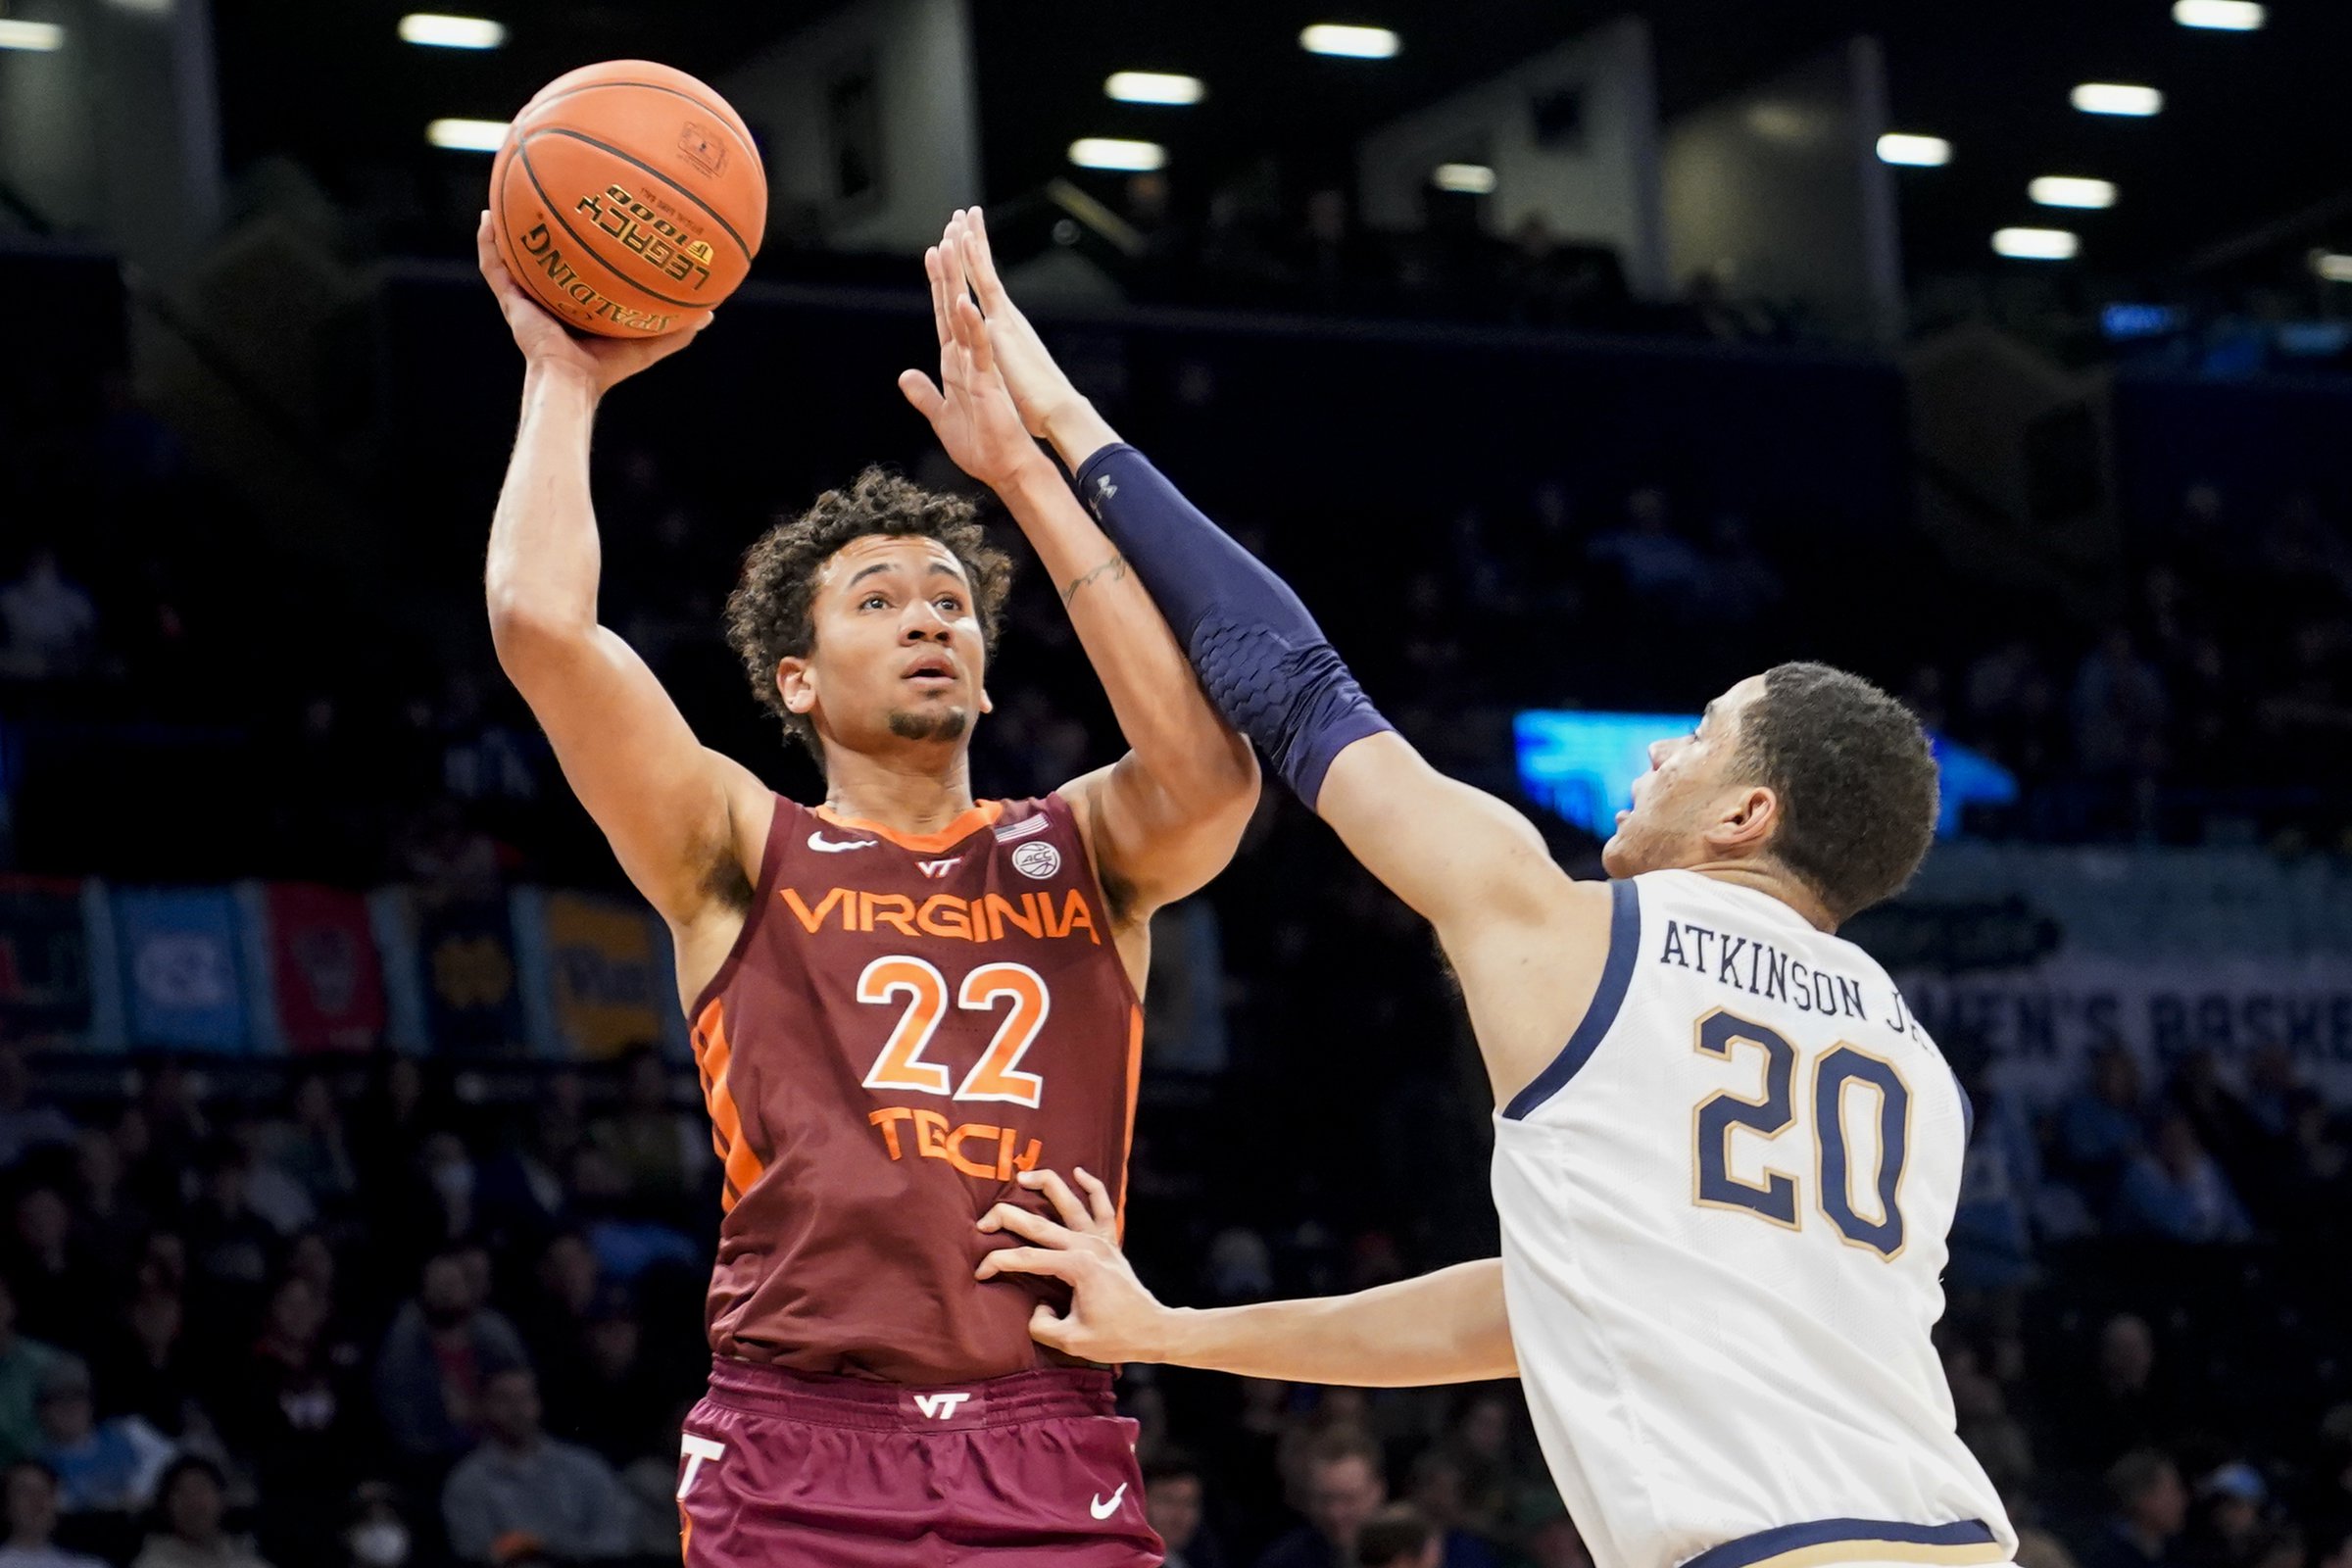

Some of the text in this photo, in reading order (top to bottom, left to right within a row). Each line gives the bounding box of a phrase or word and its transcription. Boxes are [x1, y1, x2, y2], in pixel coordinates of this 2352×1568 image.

[575, 195, 710, 290] LEGACY
[605, 183, 688, 247] 1000
[520, 221, 678, 332] SPALDING
[915, 856, 964, 878] VT
[1022, 849, 1053, 863] ACC
[780, 887, 1101, 945] VIRGINIA
[1660, 920, 1868, 1021] ATKINSON
[857, 955, 1051, 1109] 22
[868, 1106, 1043, 1182] TECH
[1692, 1004, 1914, 1264] 20
[913, 1393, 971, 1420] VT
